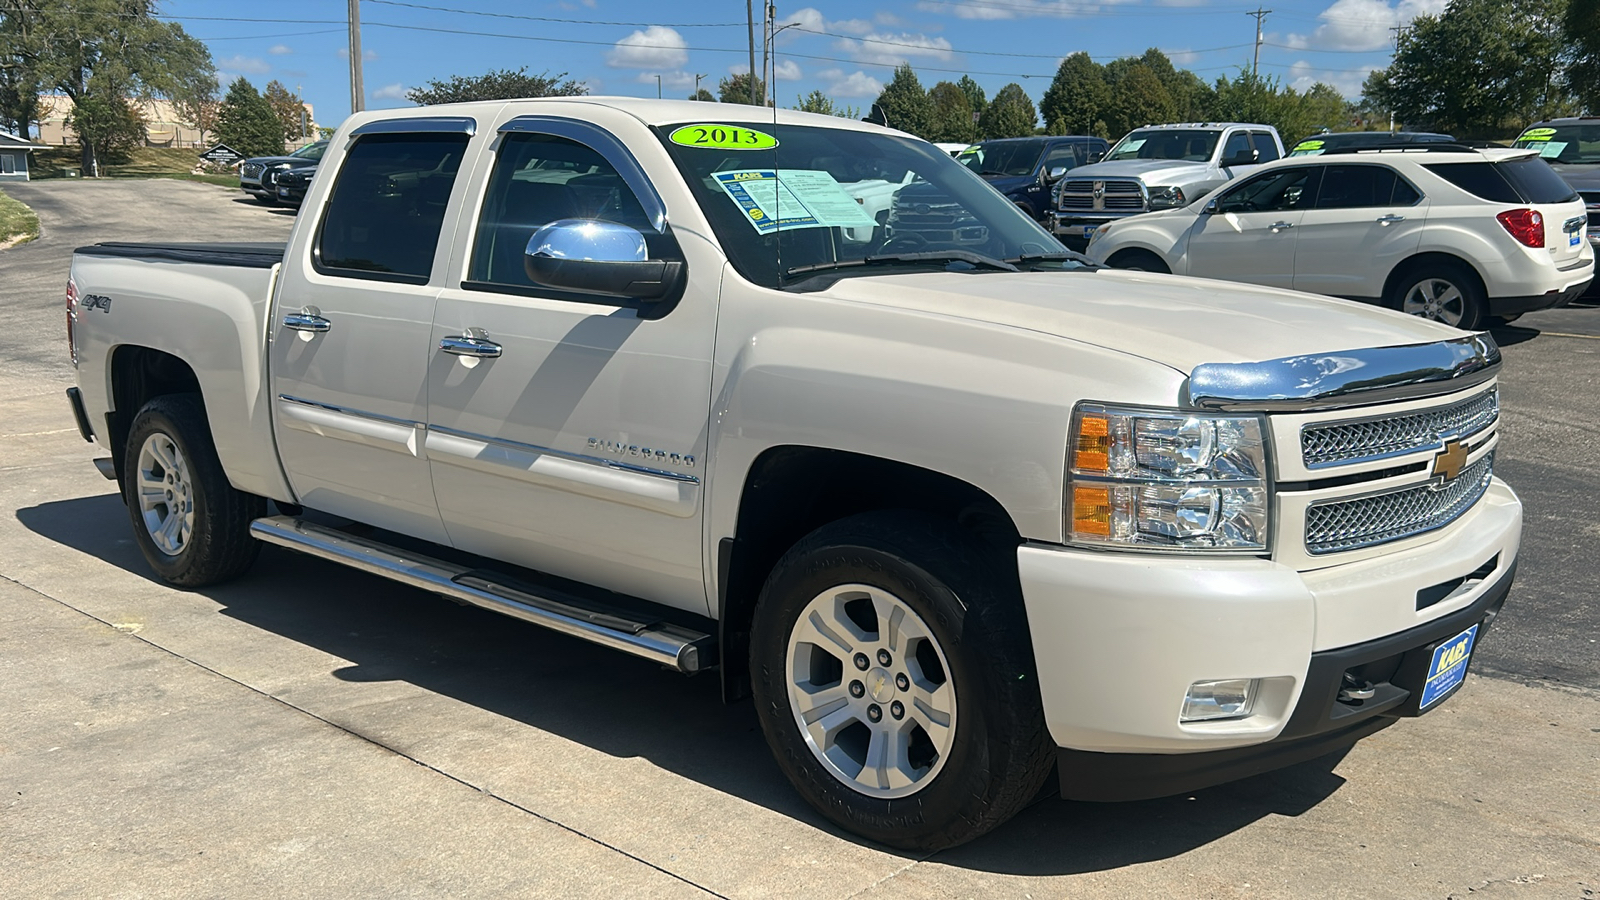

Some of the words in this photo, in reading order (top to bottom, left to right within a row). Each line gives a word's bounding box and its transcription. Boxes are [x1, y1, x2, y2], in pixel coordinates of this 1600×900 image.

[694, 128, 759, 144] 2013
[588, 437, 696, 468] SILVERADO
[1435, 637, 1468, 674] KARS
